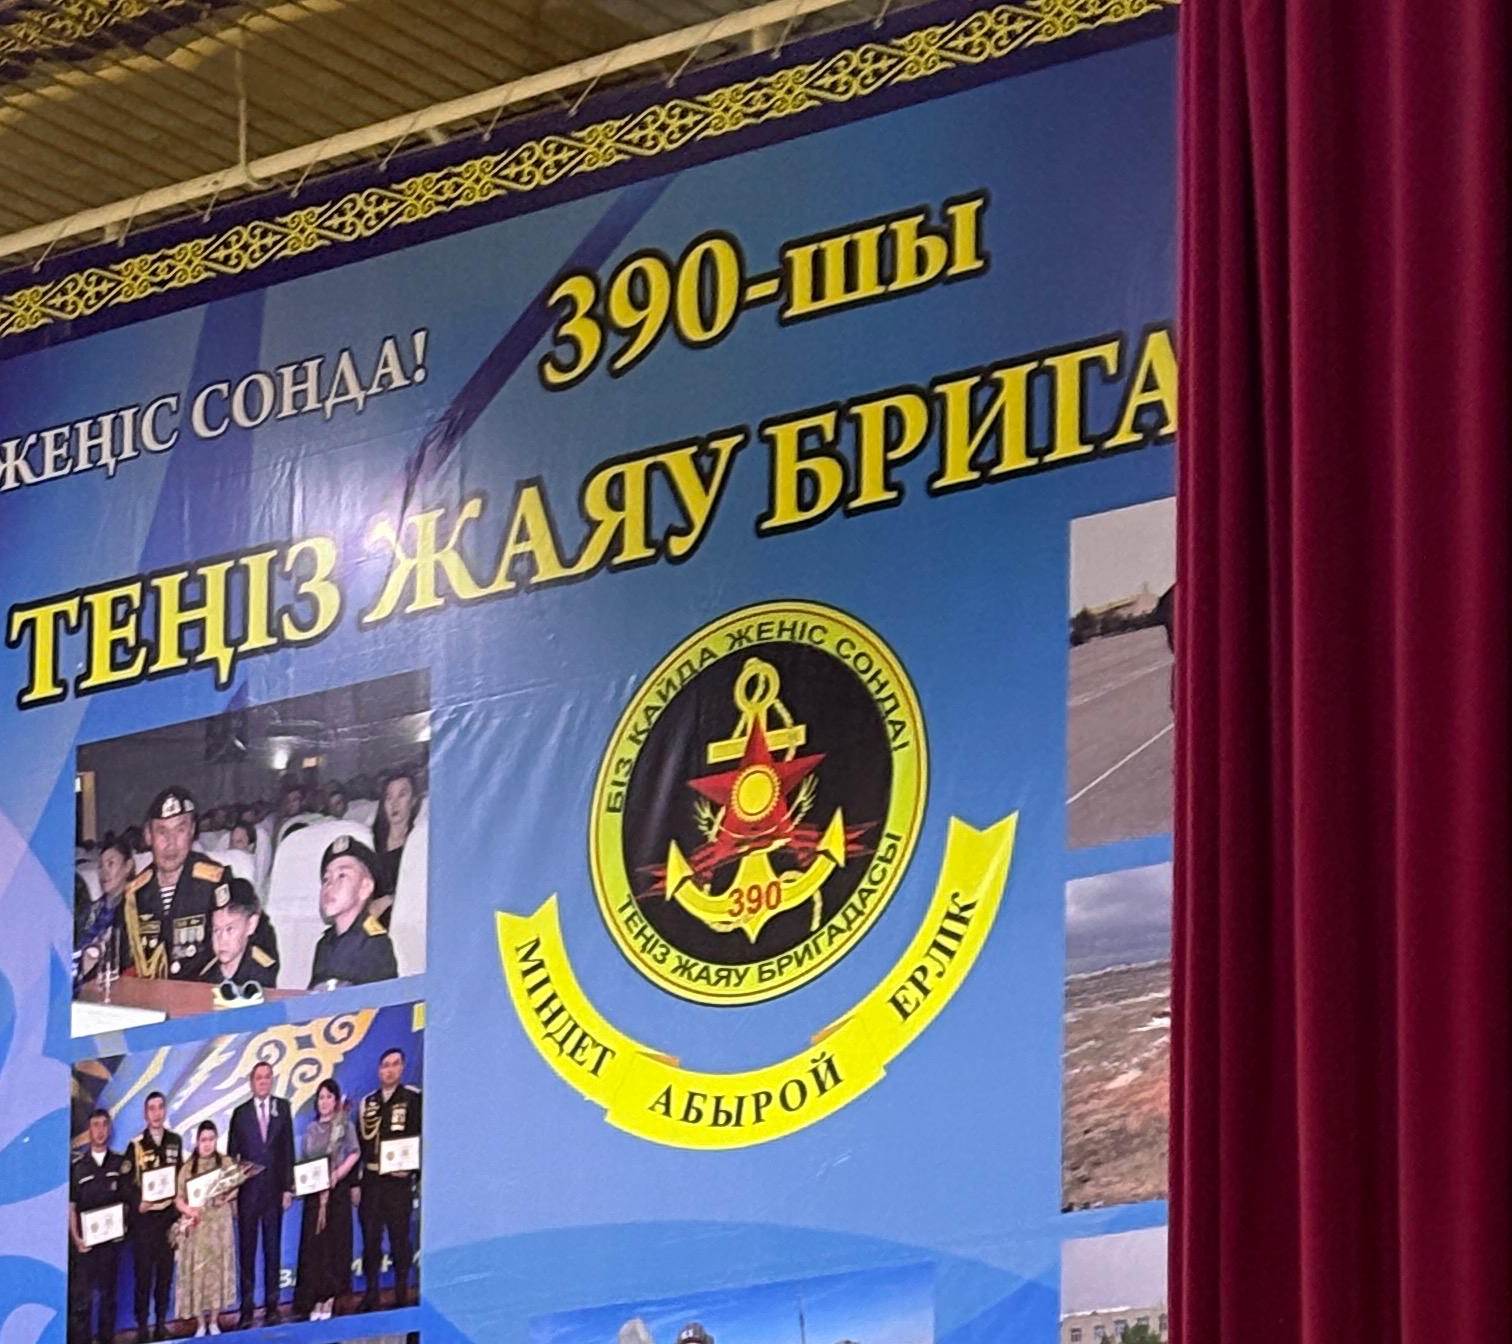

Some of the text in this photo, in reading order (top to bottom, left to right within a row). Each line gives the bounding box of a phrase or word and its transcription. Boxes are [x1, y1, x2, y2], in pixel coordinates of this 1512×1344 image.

[540, 196, 988, 388] 390-шы
[190, 329, 430, 441] СОНДА!
[9, 538, 340, 705] ТЕҢІЗ
[364, 434, 746, 622] ЖАЯУ
[606, 757, 632, 814] БІЗ
[616, 831, 903, 988] ТЕҢІЗ ЖАЯУ БРИГАДАСЫ
[727, 880, 783, 918] 390
[887, 891, 979, 1023] ЕРЛІК
[514, 936, 617, 1078] МІНДЕТ
[647, 1051, 844, 1128] АБЫРОЙ
